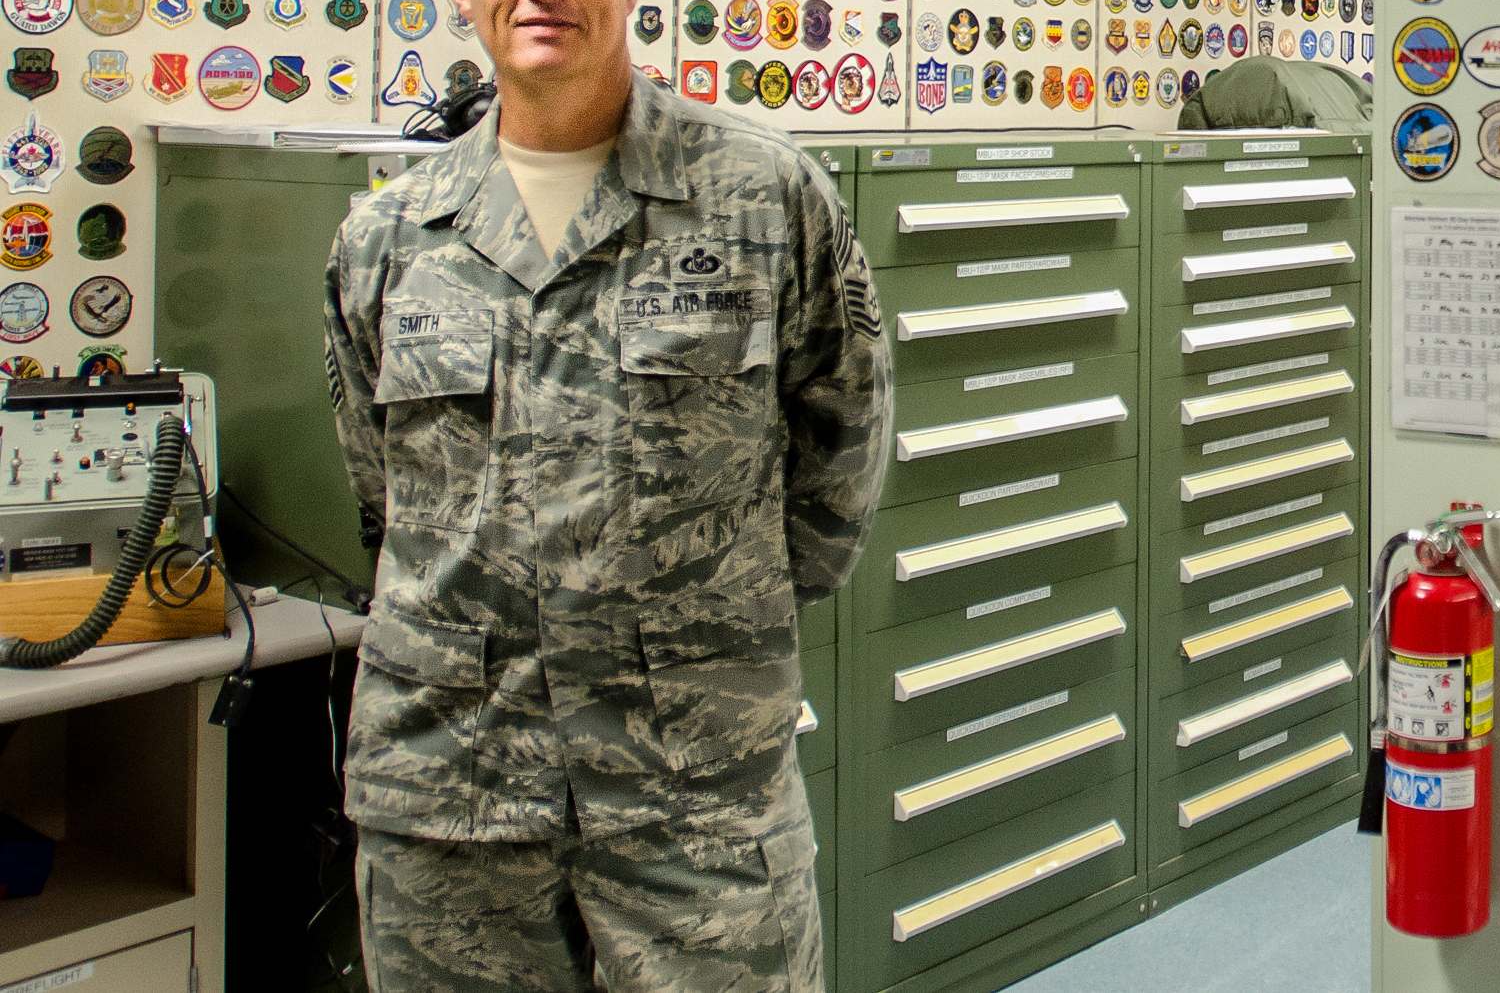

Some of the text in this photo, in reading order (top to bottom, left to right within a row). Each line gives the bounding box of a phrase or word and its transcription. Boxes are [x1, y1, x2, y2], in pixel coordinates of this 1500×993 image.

[10, 12, 38, 31] GUARD
[918, 83, 944, 107] BONE
[2, 129, 62, 156] FIFTY YEARS
[978, 148, 1052, 159] MBU-12/P SHOP STOCK
[958, 171, 990, 181] MBU-12/P
[991, 170, 1009, 180] MASK
[958, 266, 990, 276] MBU-12/P
[991, 262, 1009, 273] MASK
[672, 293, 700, 314] AIR
[705, 290, 754, 312] FORCE
[397, 313, 441, 336] SMITH
[999, 374, 1017, 382] MASK
[1017, 368, 1057, 381] ASSEMBLIES
[1396, 656, 1449, 668] INSTRUCTIONS
[1465, 664, 1471, 676] A
[7, 968, 82, 993] REFLIGHT
